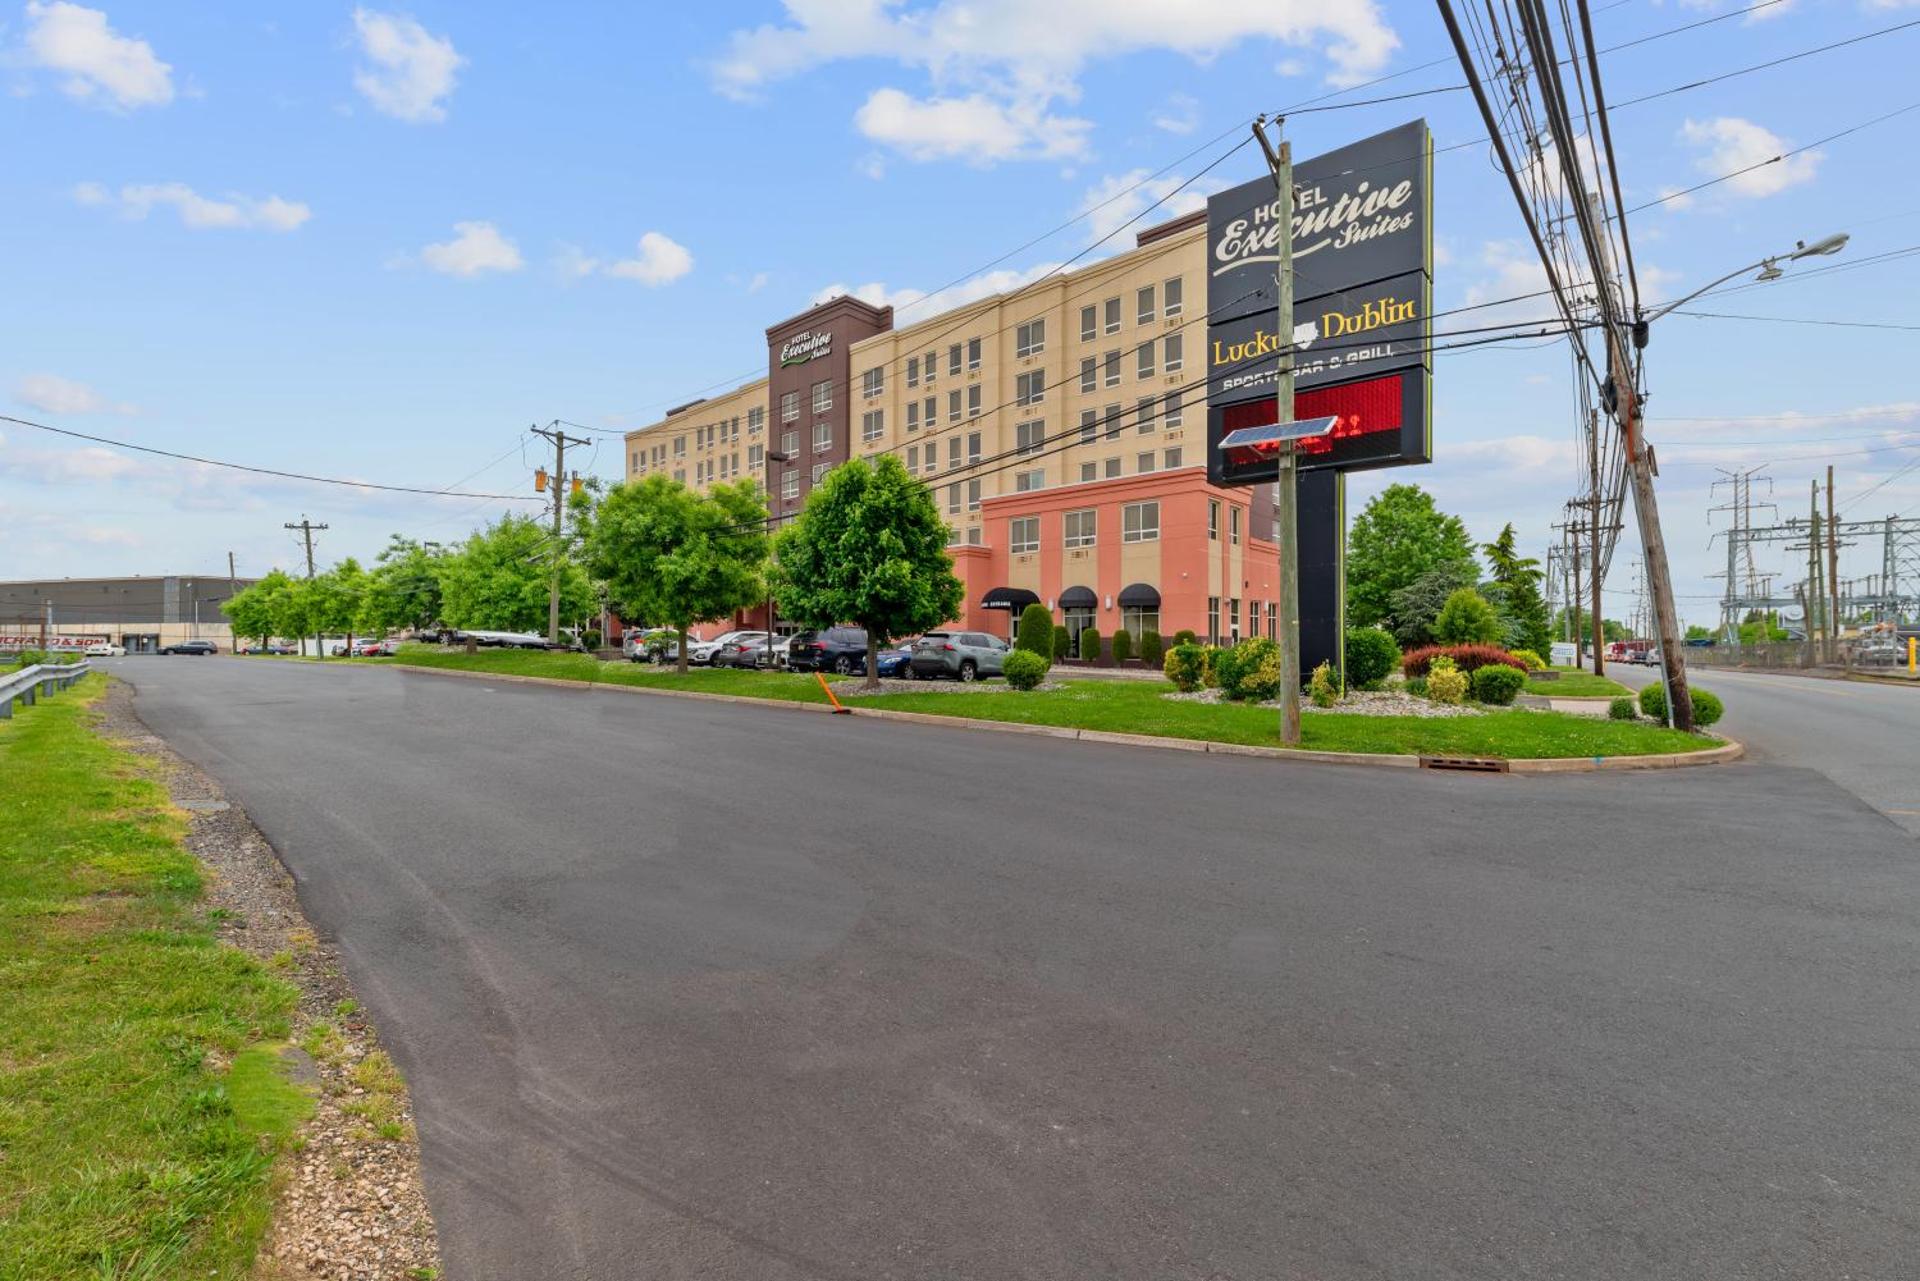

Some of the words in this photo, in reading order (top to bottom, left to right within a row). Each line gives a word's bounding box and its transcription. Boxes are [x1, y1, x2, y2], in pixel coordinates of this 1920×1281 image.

[1215, 180, 1412, 262] Executive
[1255, 186, 1328, 225] HOEL
[1333, 211, 1414, 249] Suites
[1321, 297, 1416, 339] Dublin
[1329, 356, 1344, 369] &
[1346, 344, 1395, 367] GRILL
